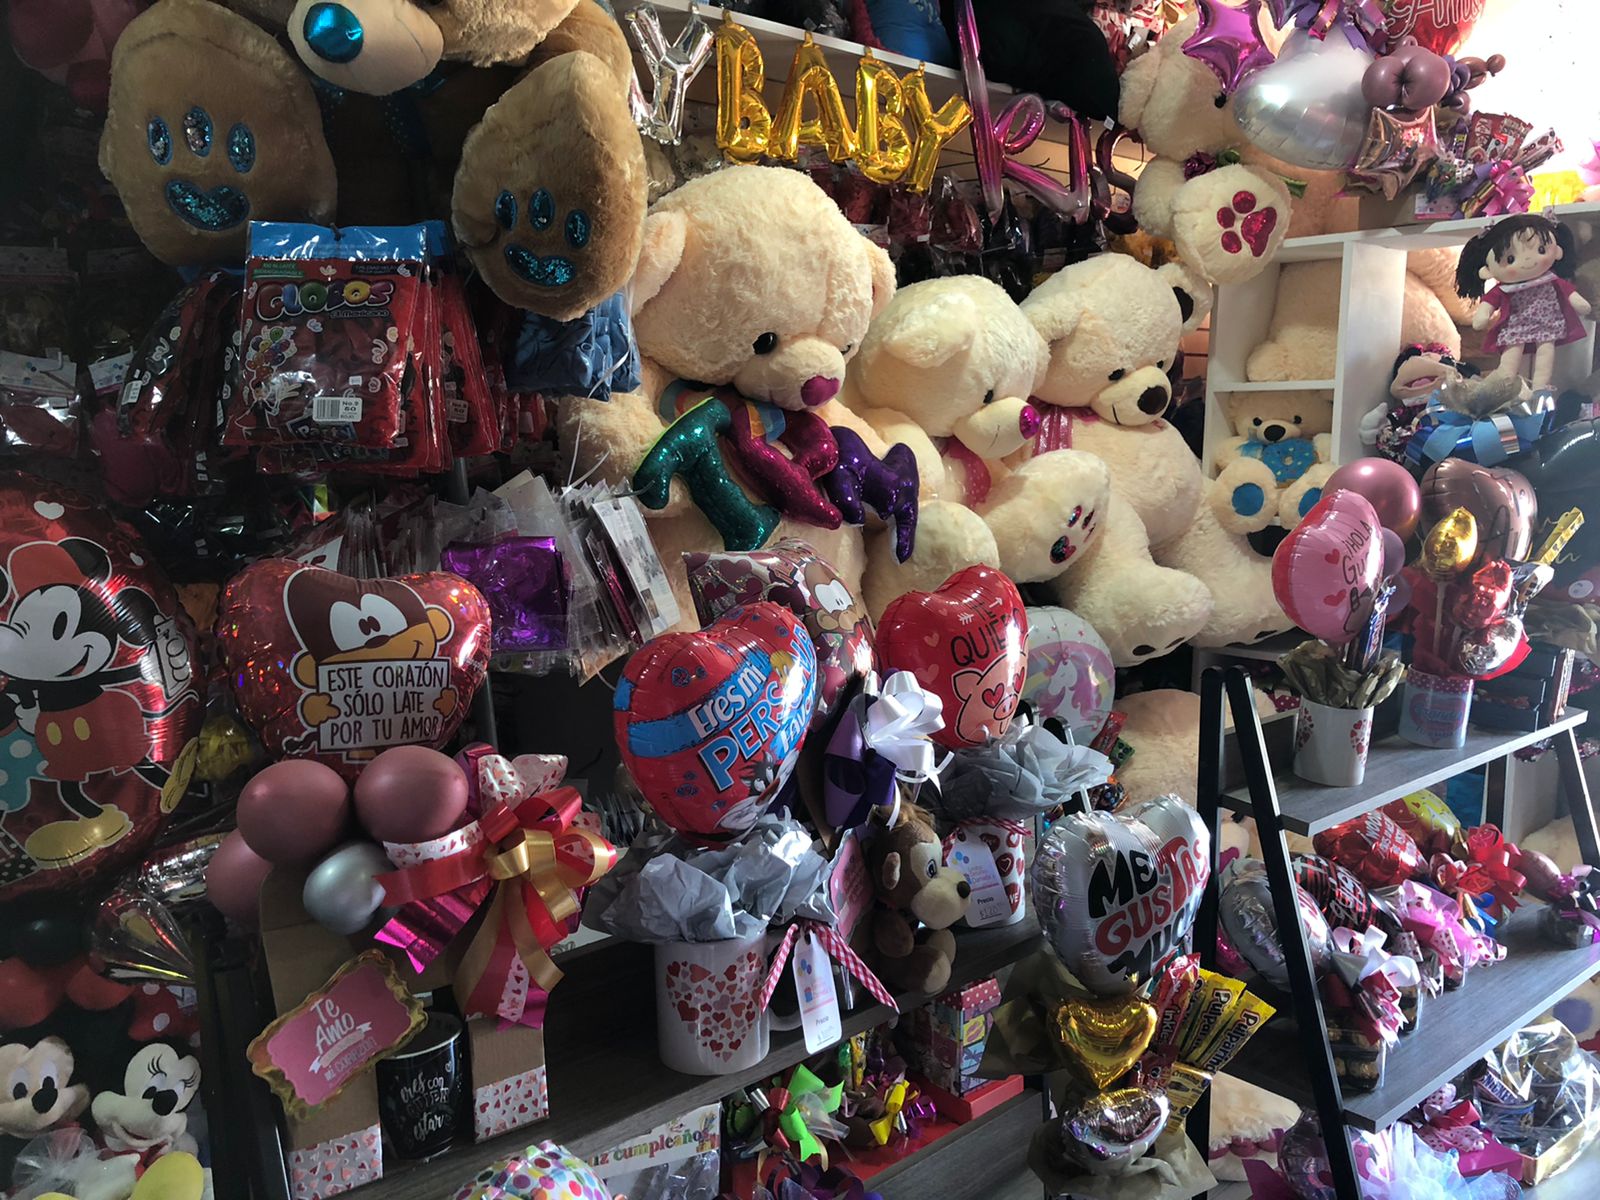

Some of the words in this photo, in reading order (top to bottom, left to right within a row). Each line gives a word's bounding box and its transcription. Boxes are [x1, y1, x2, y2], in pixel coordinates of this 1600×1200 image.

[713, 9, 975, 193] BABY
[327, 667, 363, 692] ESTE
[373, 663, 444, 689] CORAZÓN
[343, 690, 385, 718] SÓLO
[393, 690, 425, 715] LATE
[688, 684, 746, 738] Eres
[740, 662, 767, 698] mi
[330, 721, 363, 746] POR
[372, 718, 393, 740] TU
[400, 716, 440, 740] AMOR
[1088, 849, 1158, 919] ME
[310, 998, 340, 1025] Te
[314, 1012, 355, 1056] Amo
